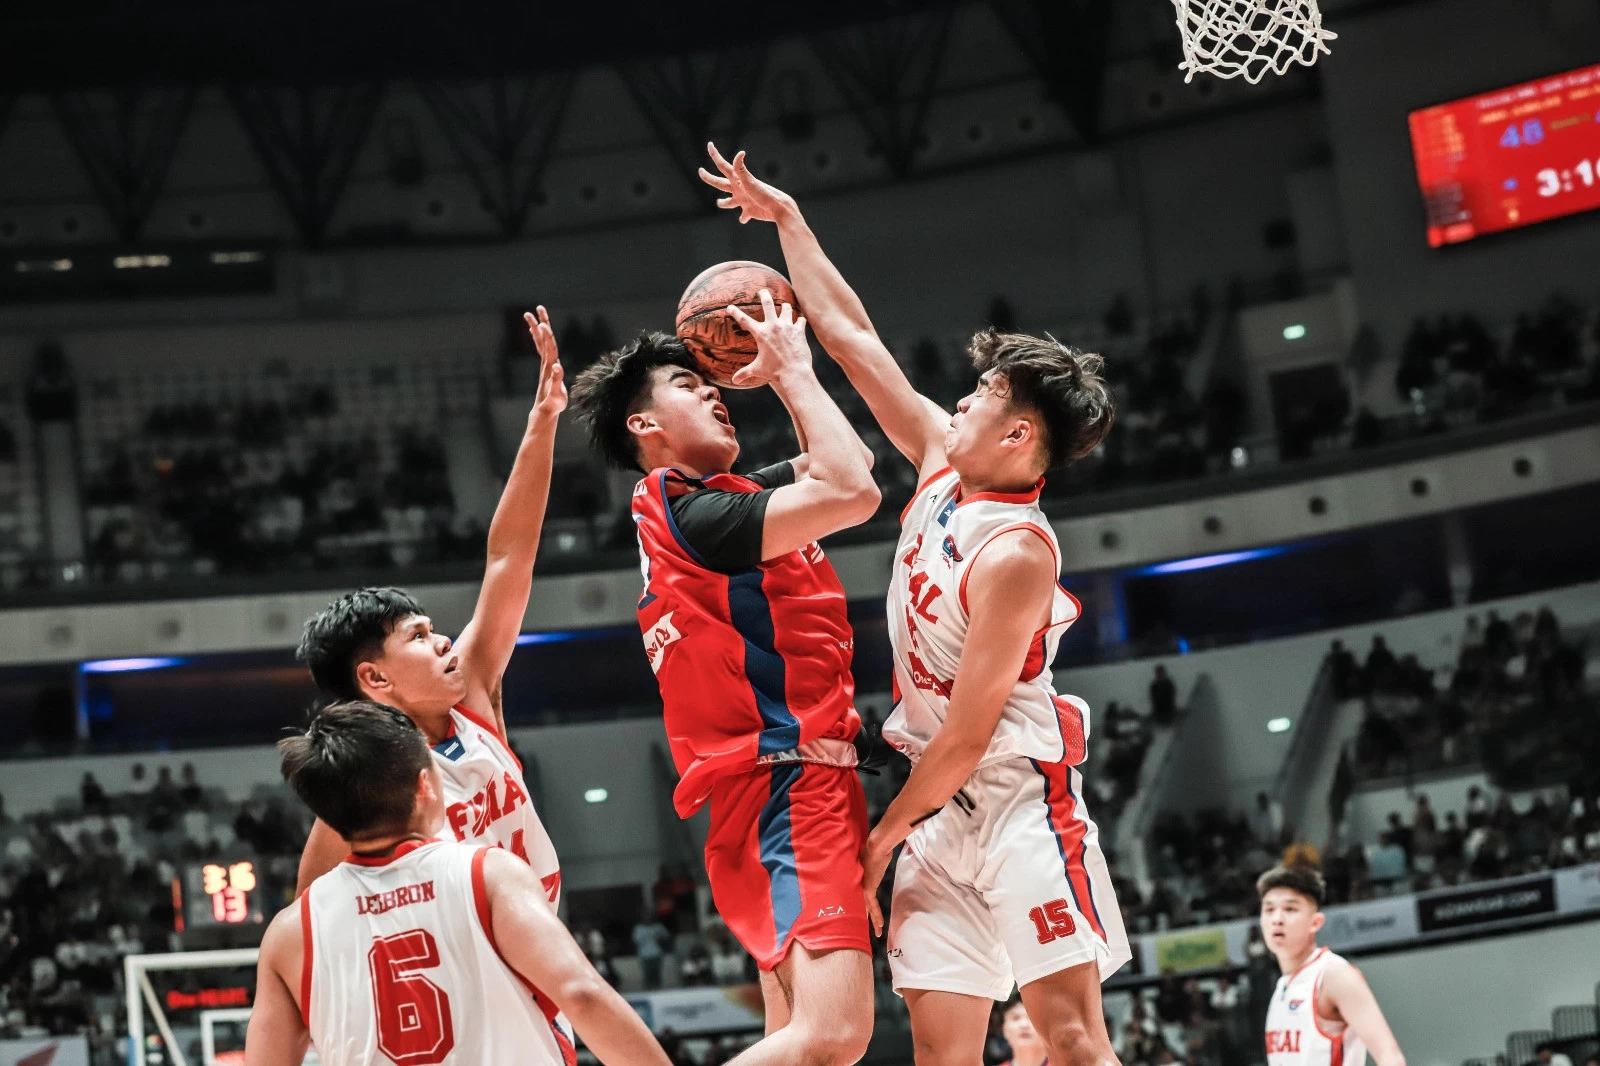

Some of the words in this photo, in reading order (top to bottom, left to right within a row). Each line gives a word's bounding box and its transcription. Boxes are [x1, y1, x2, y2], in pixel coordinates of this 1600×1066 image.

[1536, 158, 1600, 197] 3:1
[1029, 898, 1076, 945] 15
[368, 928, 455, 1066] 6
